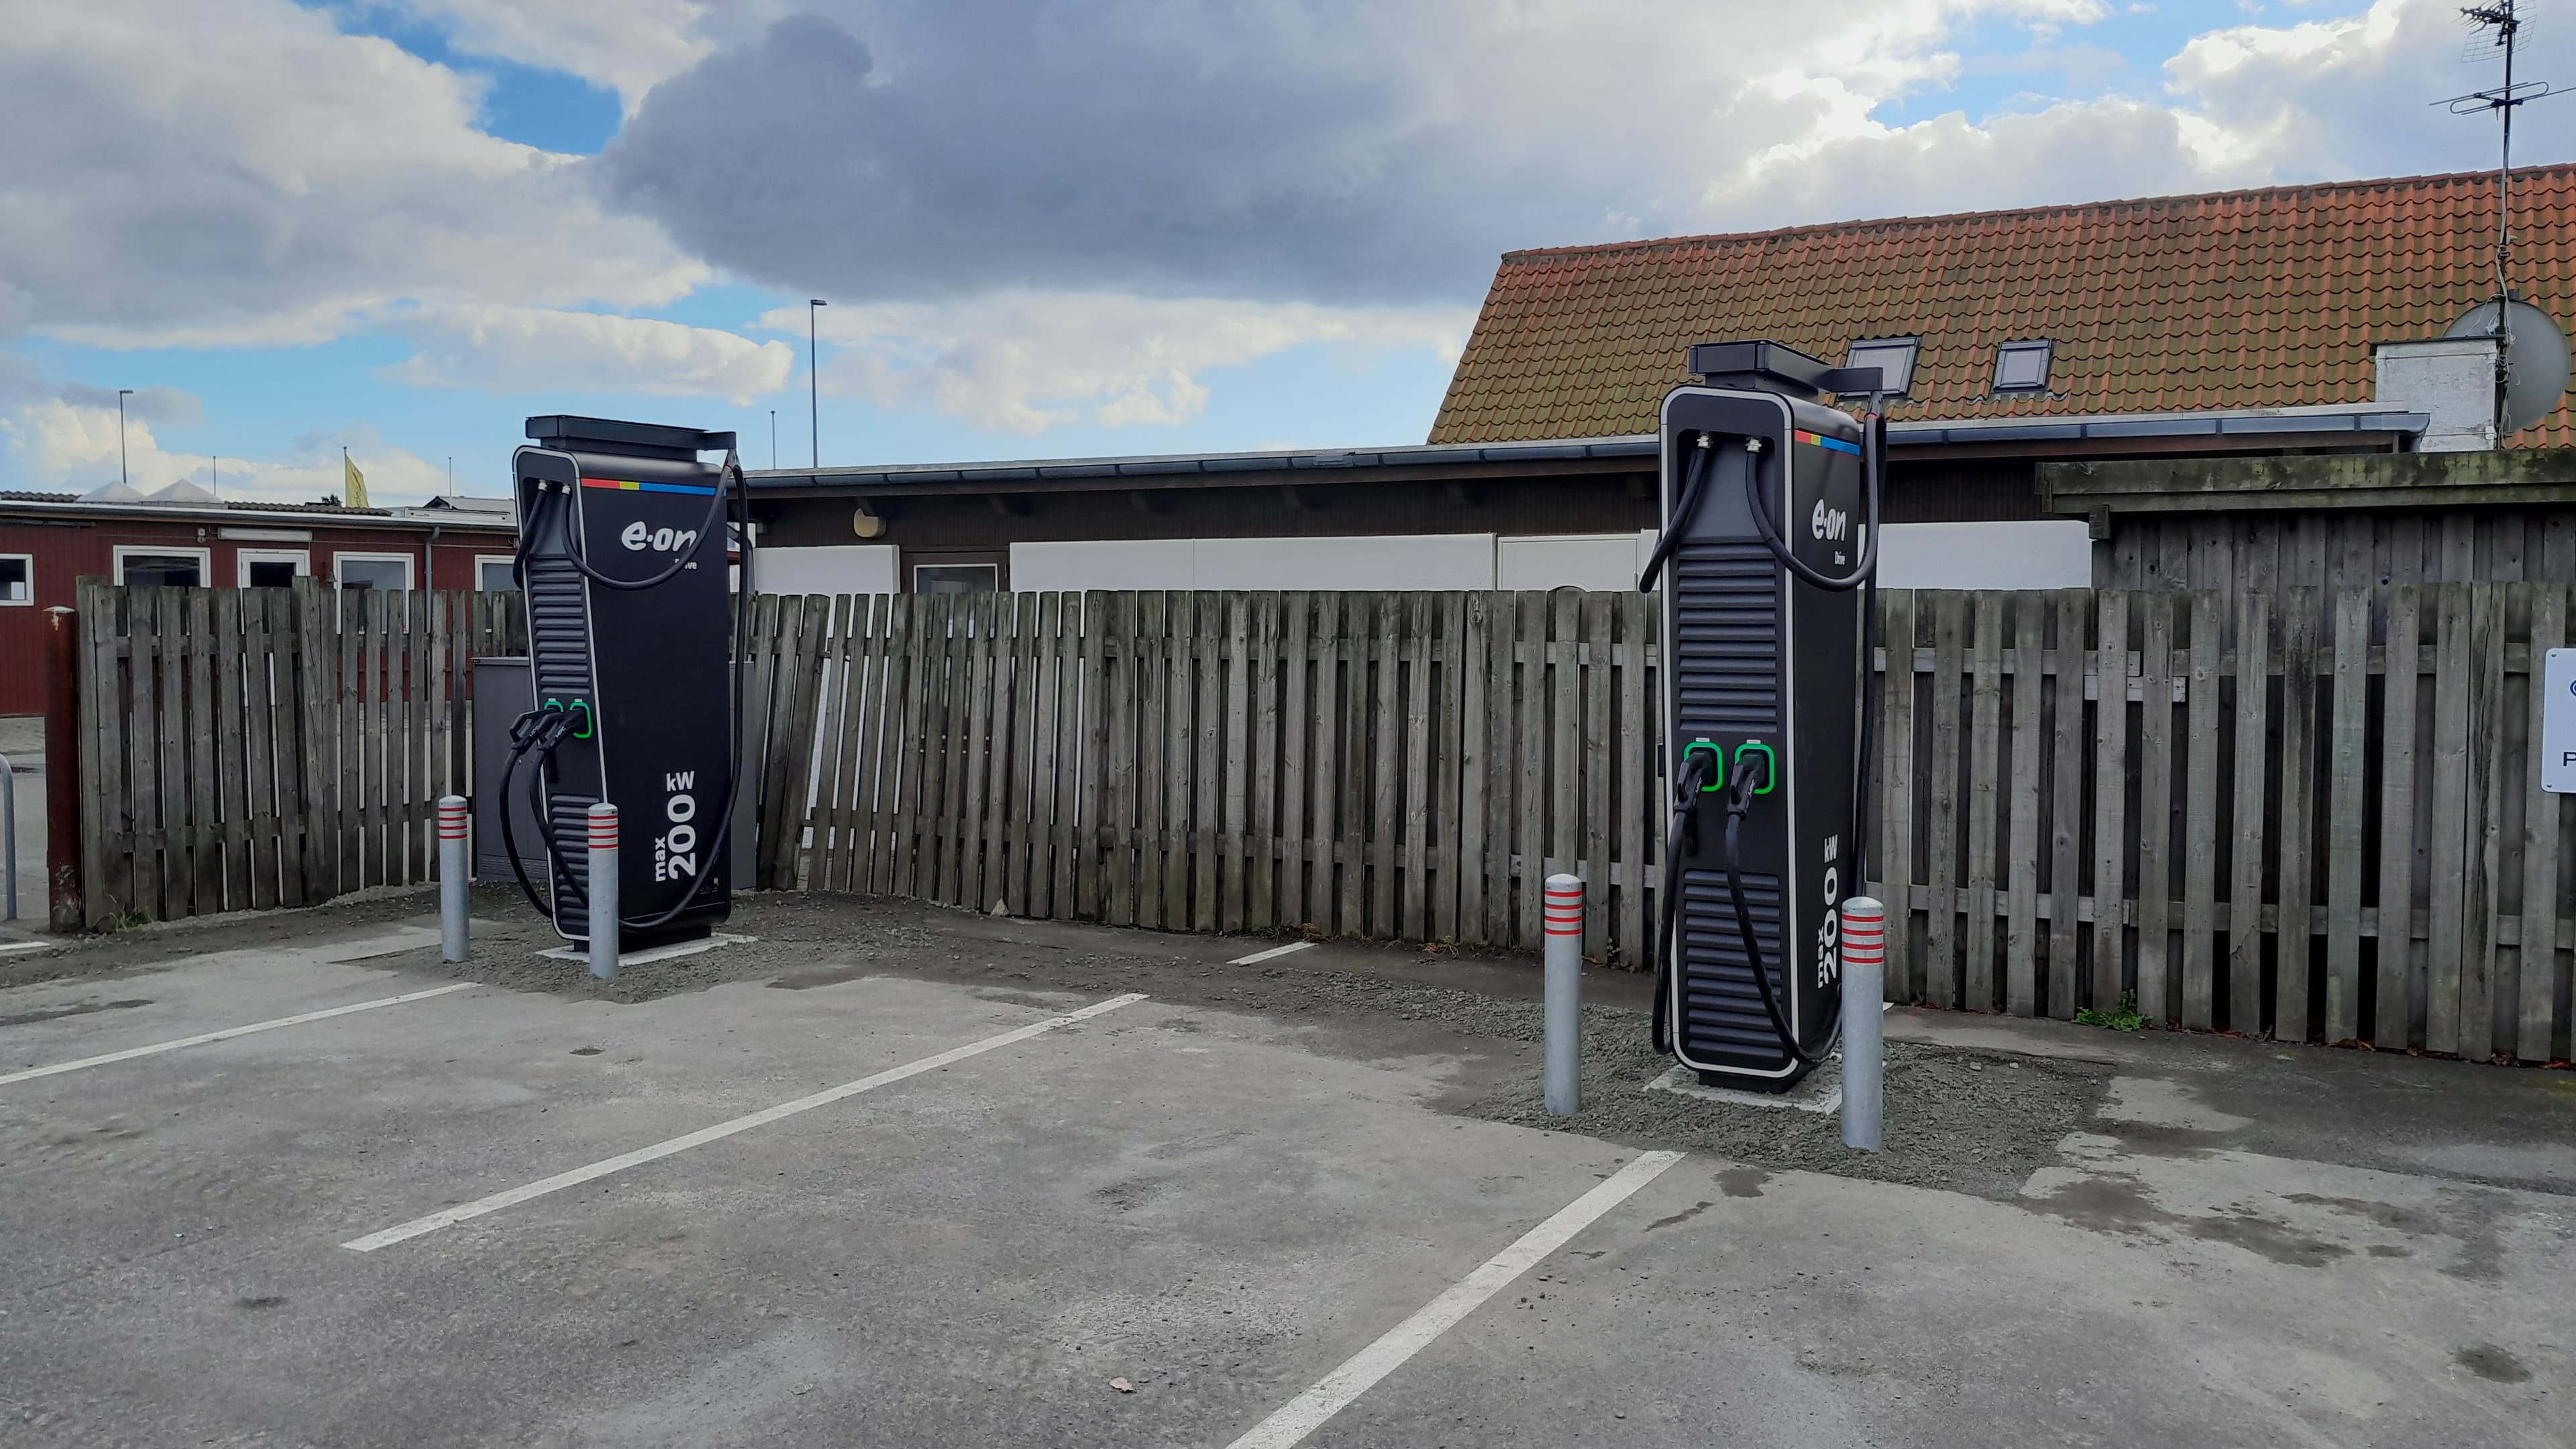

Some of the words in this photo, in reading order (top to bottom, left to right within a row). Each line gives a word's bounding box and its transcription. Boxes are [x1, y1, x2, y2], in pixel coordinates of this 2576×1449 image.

[666, 770, 695, 792] kW
[655, 836, 666, 882] max
[667, 794, 696, 880] 200
[1824, 834, 1838, 864] kW
[1823, 867, 1838, 985] 200
